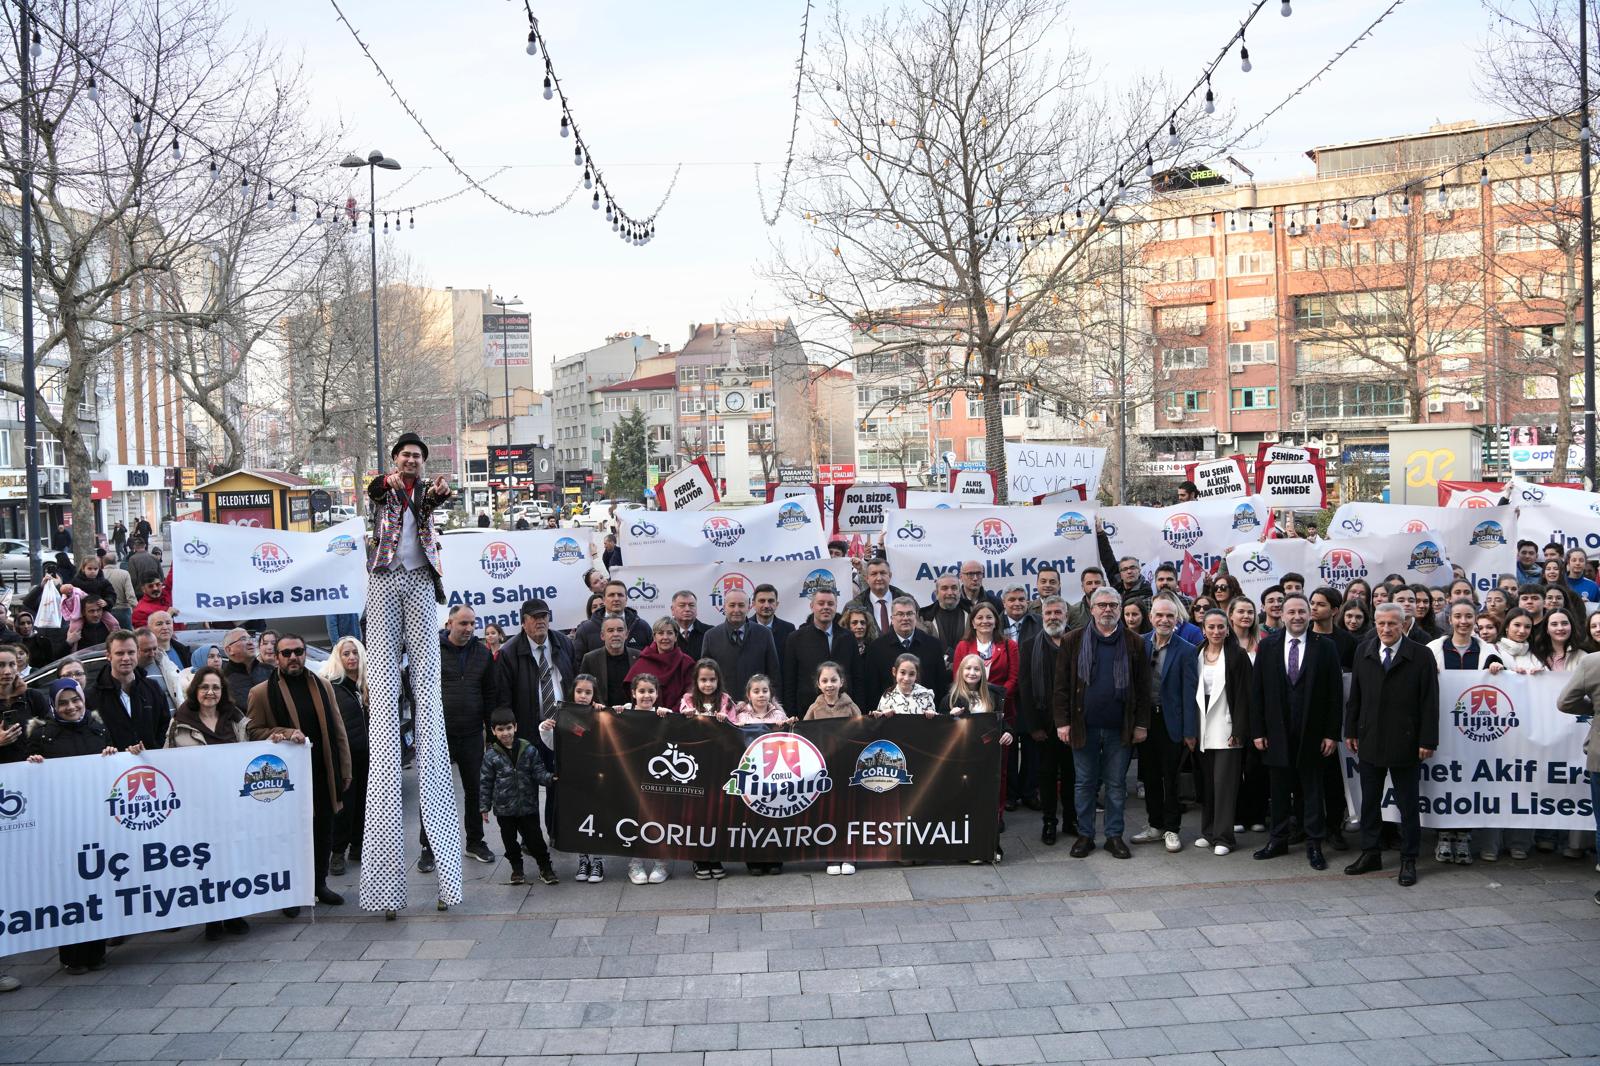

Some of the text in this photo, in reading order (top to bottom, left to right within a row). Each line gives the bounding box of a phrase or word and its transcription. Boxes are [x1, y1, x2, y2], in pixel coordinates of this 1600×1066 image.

[1018, 450, 1095, 469] ASLAN ALİ
[1272, 452, 1304, 461] ŞEHİRDE
[1200, 465, 1234, 479] BU ŞEHİR
[1206, 476, 1230, 487] ALKIŞI
[1267, 475, 1314, 485] DUYGULAR
[673, 478, 696, 498] PERDE
[962, 487, 985, 495] ZAMANI
[1199, 483, 1242, 498] HAK EDİYOR
[1271, 486, 1310, 495] SAHNEDE
[218, 493, 270, 506] BELEDİYE TAKSİ
[674, 487, 703, 510] AÇILIYOR
[847, 492, 894, 504] ROL BİZDE,
[858, 504, 883, 515] ALKIŞ
[849, 515, 885, 527] ÇORLU'D
[1550, 530, 1579, 549] Ün
[916, 559, 1015, 583] Aydlık
[1021, 556, 1076, 576] Kent
[195, 584, 349, 610] Rapiska Sanat
[447, 584, 557, 608] Ata Sahne
[1449, 706, 1520, 732] Tiyatro
[1463, 727, 1505, 742] FESTİVALİ
[771, 772, 792, 781] ÇORLU
[1471, 758, 1537, 783] Akif
[1547, 761, 1592, 785] Ers
[730, 764, 833, 804] Tiyatro
[104, 791, 181, 821] Tiyatro
[749, 795, 811, 817] FESTİVALİ
[1381, 787, 1593, 817] Aadolu Lises
[0, 820, 36, 832] ELEDİYESİ
[120, 812, 167, 831] FESTİVALİ
[577, 814, 970, 848] 4. ÇORLU TİYATRO FESTİVALİ
[77, 842, 212, 882] Üç Beş
[0, 870, 291, 937] anat Tiyatrosu
